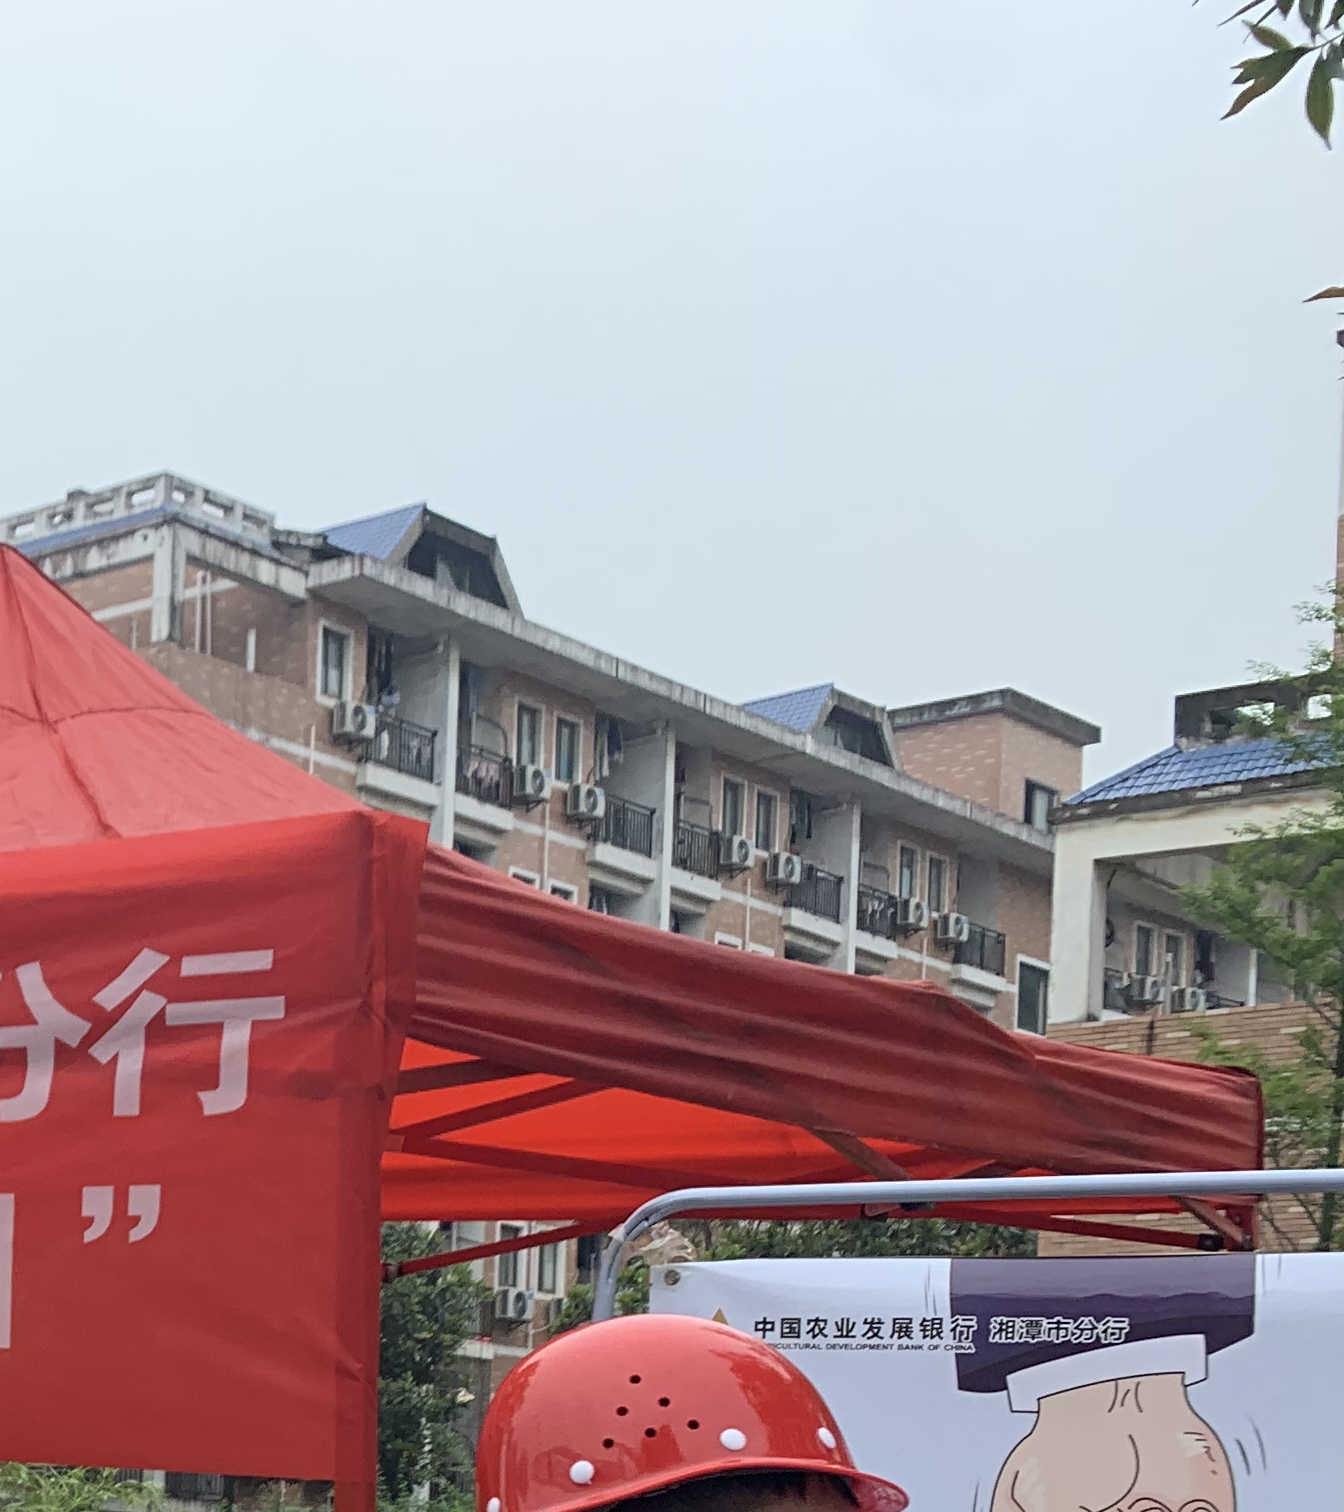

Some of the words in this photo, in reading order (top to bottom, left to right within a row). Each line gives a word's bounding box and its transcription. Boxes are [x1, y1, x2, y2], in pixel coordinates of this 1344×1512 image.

[753, 1314, 978, 1343] 中国农业发展银行
[989, 1316, 1130, 1344] 湘潭市分行
[826, 1342, 893, 1351] DEVELOPMENT
[898, 1343, 923, 1351] BANK
[928, 1343, 940, 1351] OF
[944, 1343, 974, 1352] CHINA
